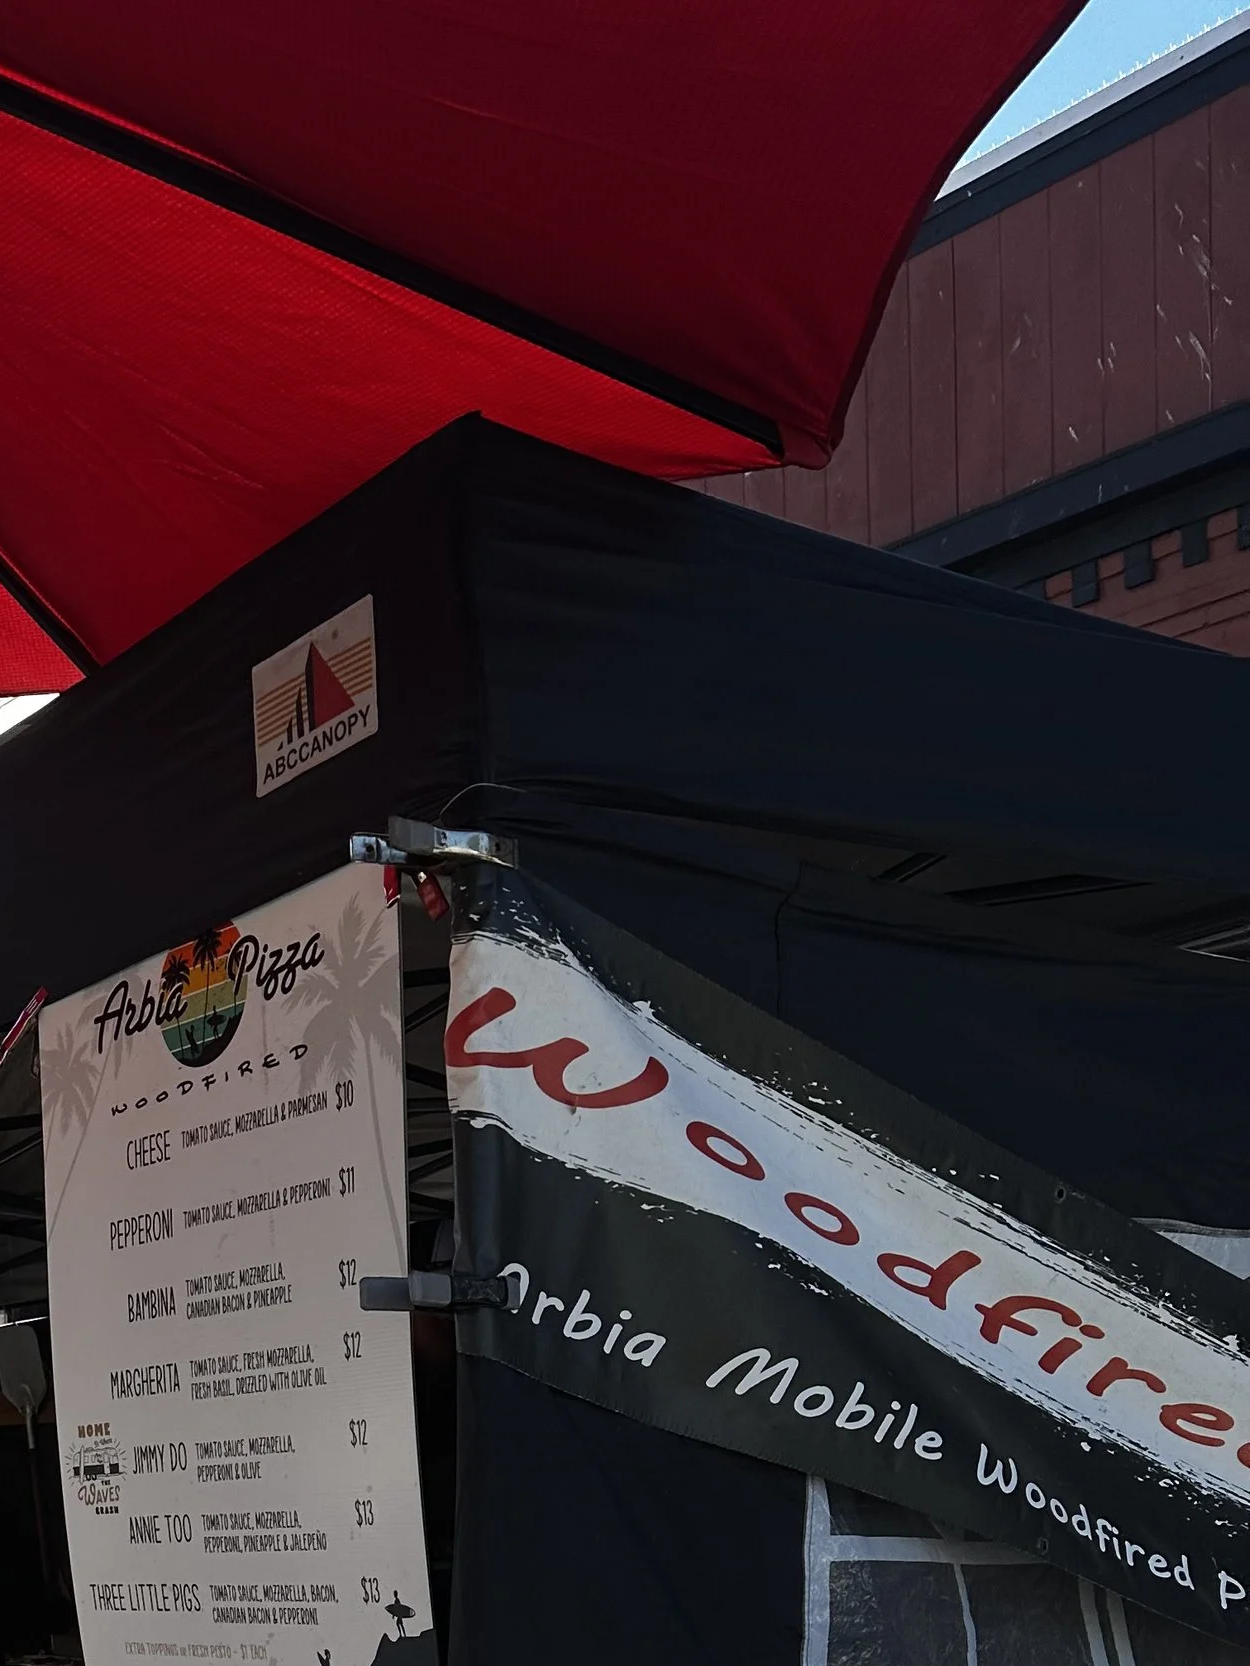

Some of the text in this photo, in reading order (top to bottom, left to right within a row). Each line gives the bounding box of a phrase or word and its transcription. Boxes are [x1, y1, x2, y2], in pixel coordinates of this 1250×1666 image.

[263, 704, 371, 785] ABCCANOPY
[94, 933, 324, 1054] Arbia Pizza
[111, 1044, 308, 1116] WOODFIRED
[126, 1079, 354, 1170] CHEESE TOMATO SAUCE, MOZZARELLA & PARMESAN $10
[110, 1166, 355, 1251] PEPPERONI TOMATO SAUCE, MOZZARELLA & PEPPERONI $11
[444, 987, 1250, 1470] Woodfire
[128, 1286, 176, 1323] BAMBINA
[186, 1276, 212, 1297] TOMATO
[214, 1270, 238, 1291] SAUCE,
[339, 1258, 357, 1289] $12
[186, 1284, 292, 1320] CANADIAN BACON & PINEAPPLE
[110, 1363, 180, 1400] MARGHERITA
[190, 1358, 217, 1379] TOMATO
[218, 1355, 242, 1374] SAUCE,
[243, 1352, 264, 1371] FRESH
[343, 1331, 361, 1361] $12
[191, 1367, 327, 1401] FRESH BASIL, DRIZZLED WITH OLIVE OIL
[78, 1422, 110, 1438] HOME
[133, 1418, 368, 1474] JIMMY DO TOMATO SAUCE, MOZZARELLA, $12
[496, 1262, 1196, 1591] Arbia Mobile Woodfired
[197, 1461, 261, 1482] PEPPERONI & OLIVE
[130, 1499, 374, 1544] ANNIE TOO TOMATO SAUCE, MOZZARELLA, $13
[204, 1530, 327, 1553] PEPPERONI, PINEAPPLE & JALEPEÑO
[90, 1576, 381, 1612] THREE LITTLE PIGS TOMATO SAUCE, MOZZARELLA, BACON, $13
[212, 1607, 319, 1625] CANADIAN BACON & PEPPERONI
[188, 1644, 209, 1658] FRESH
[250, 1645, 267, 1660] EACH
